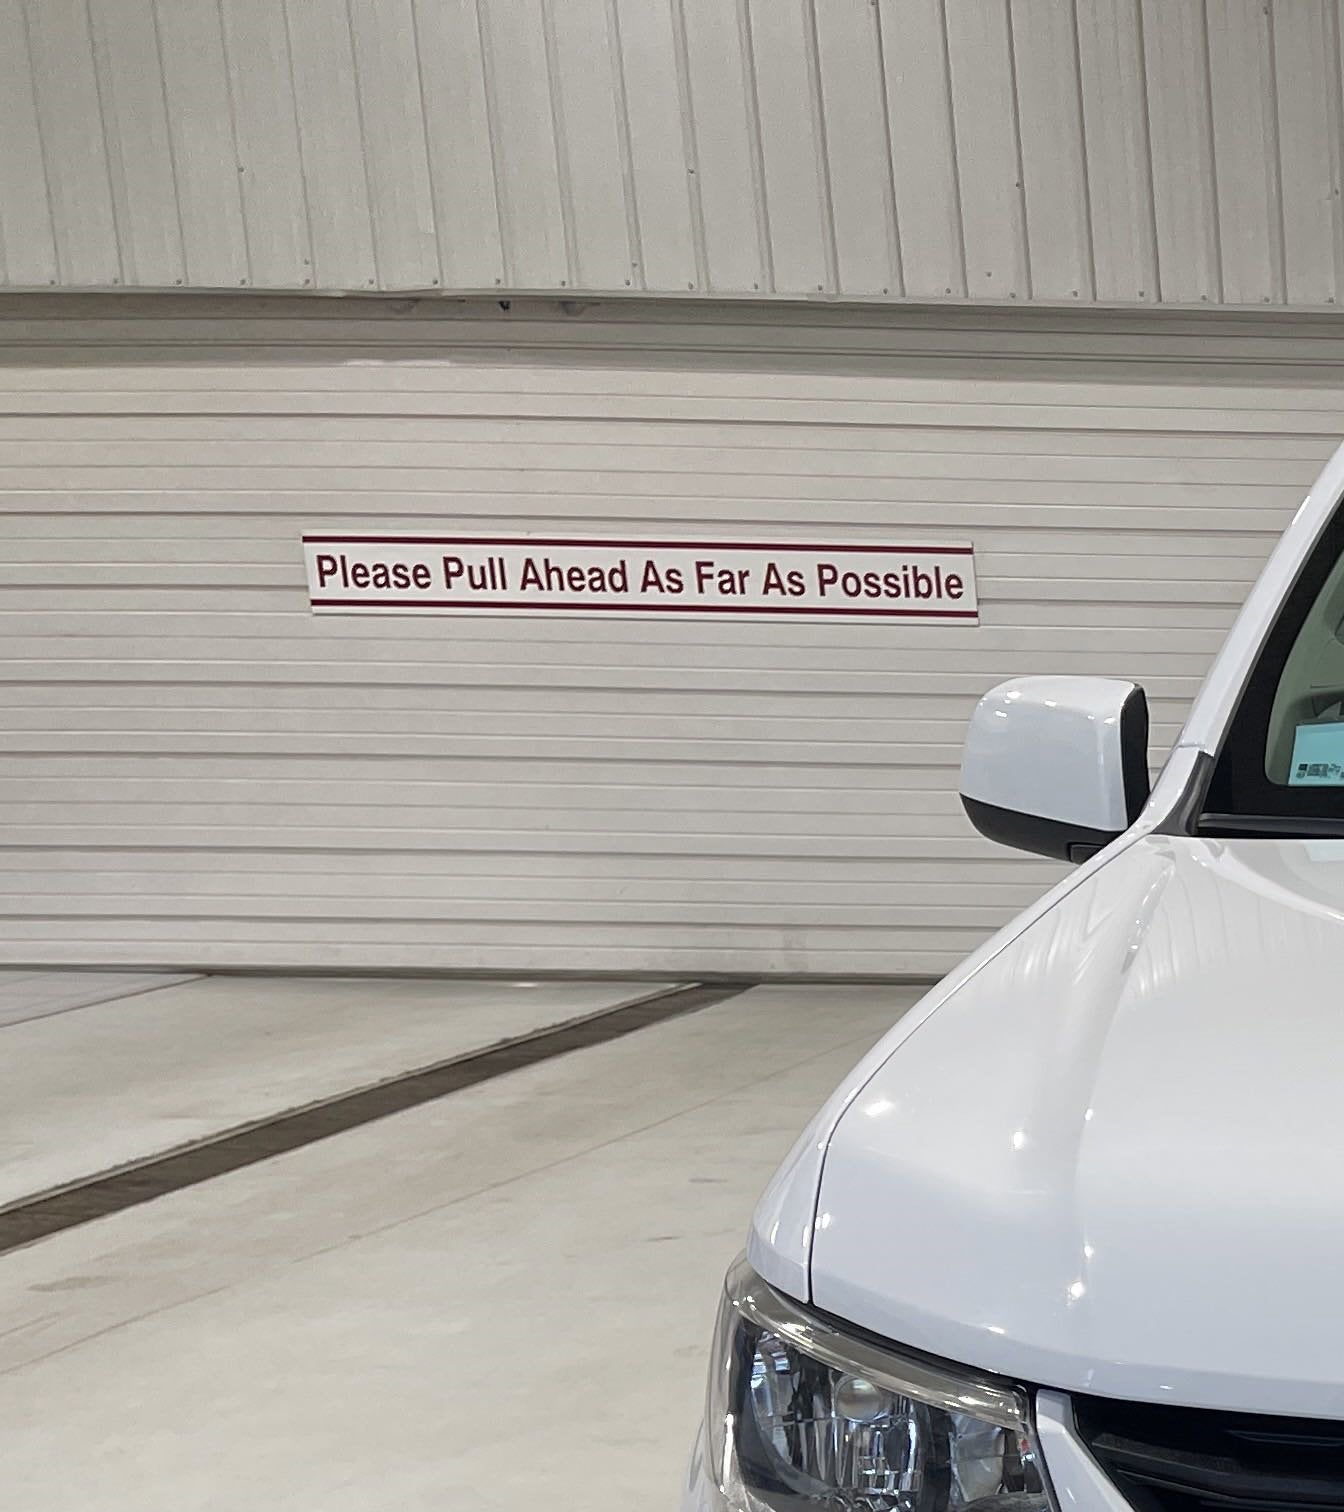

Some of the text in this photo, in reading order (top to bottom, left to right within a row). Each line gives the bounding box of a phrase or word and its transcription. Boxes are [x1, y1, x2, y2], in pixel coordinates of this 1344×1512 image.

[316, 554, 964, 599] Please Pull Ahead As Far As Possible
